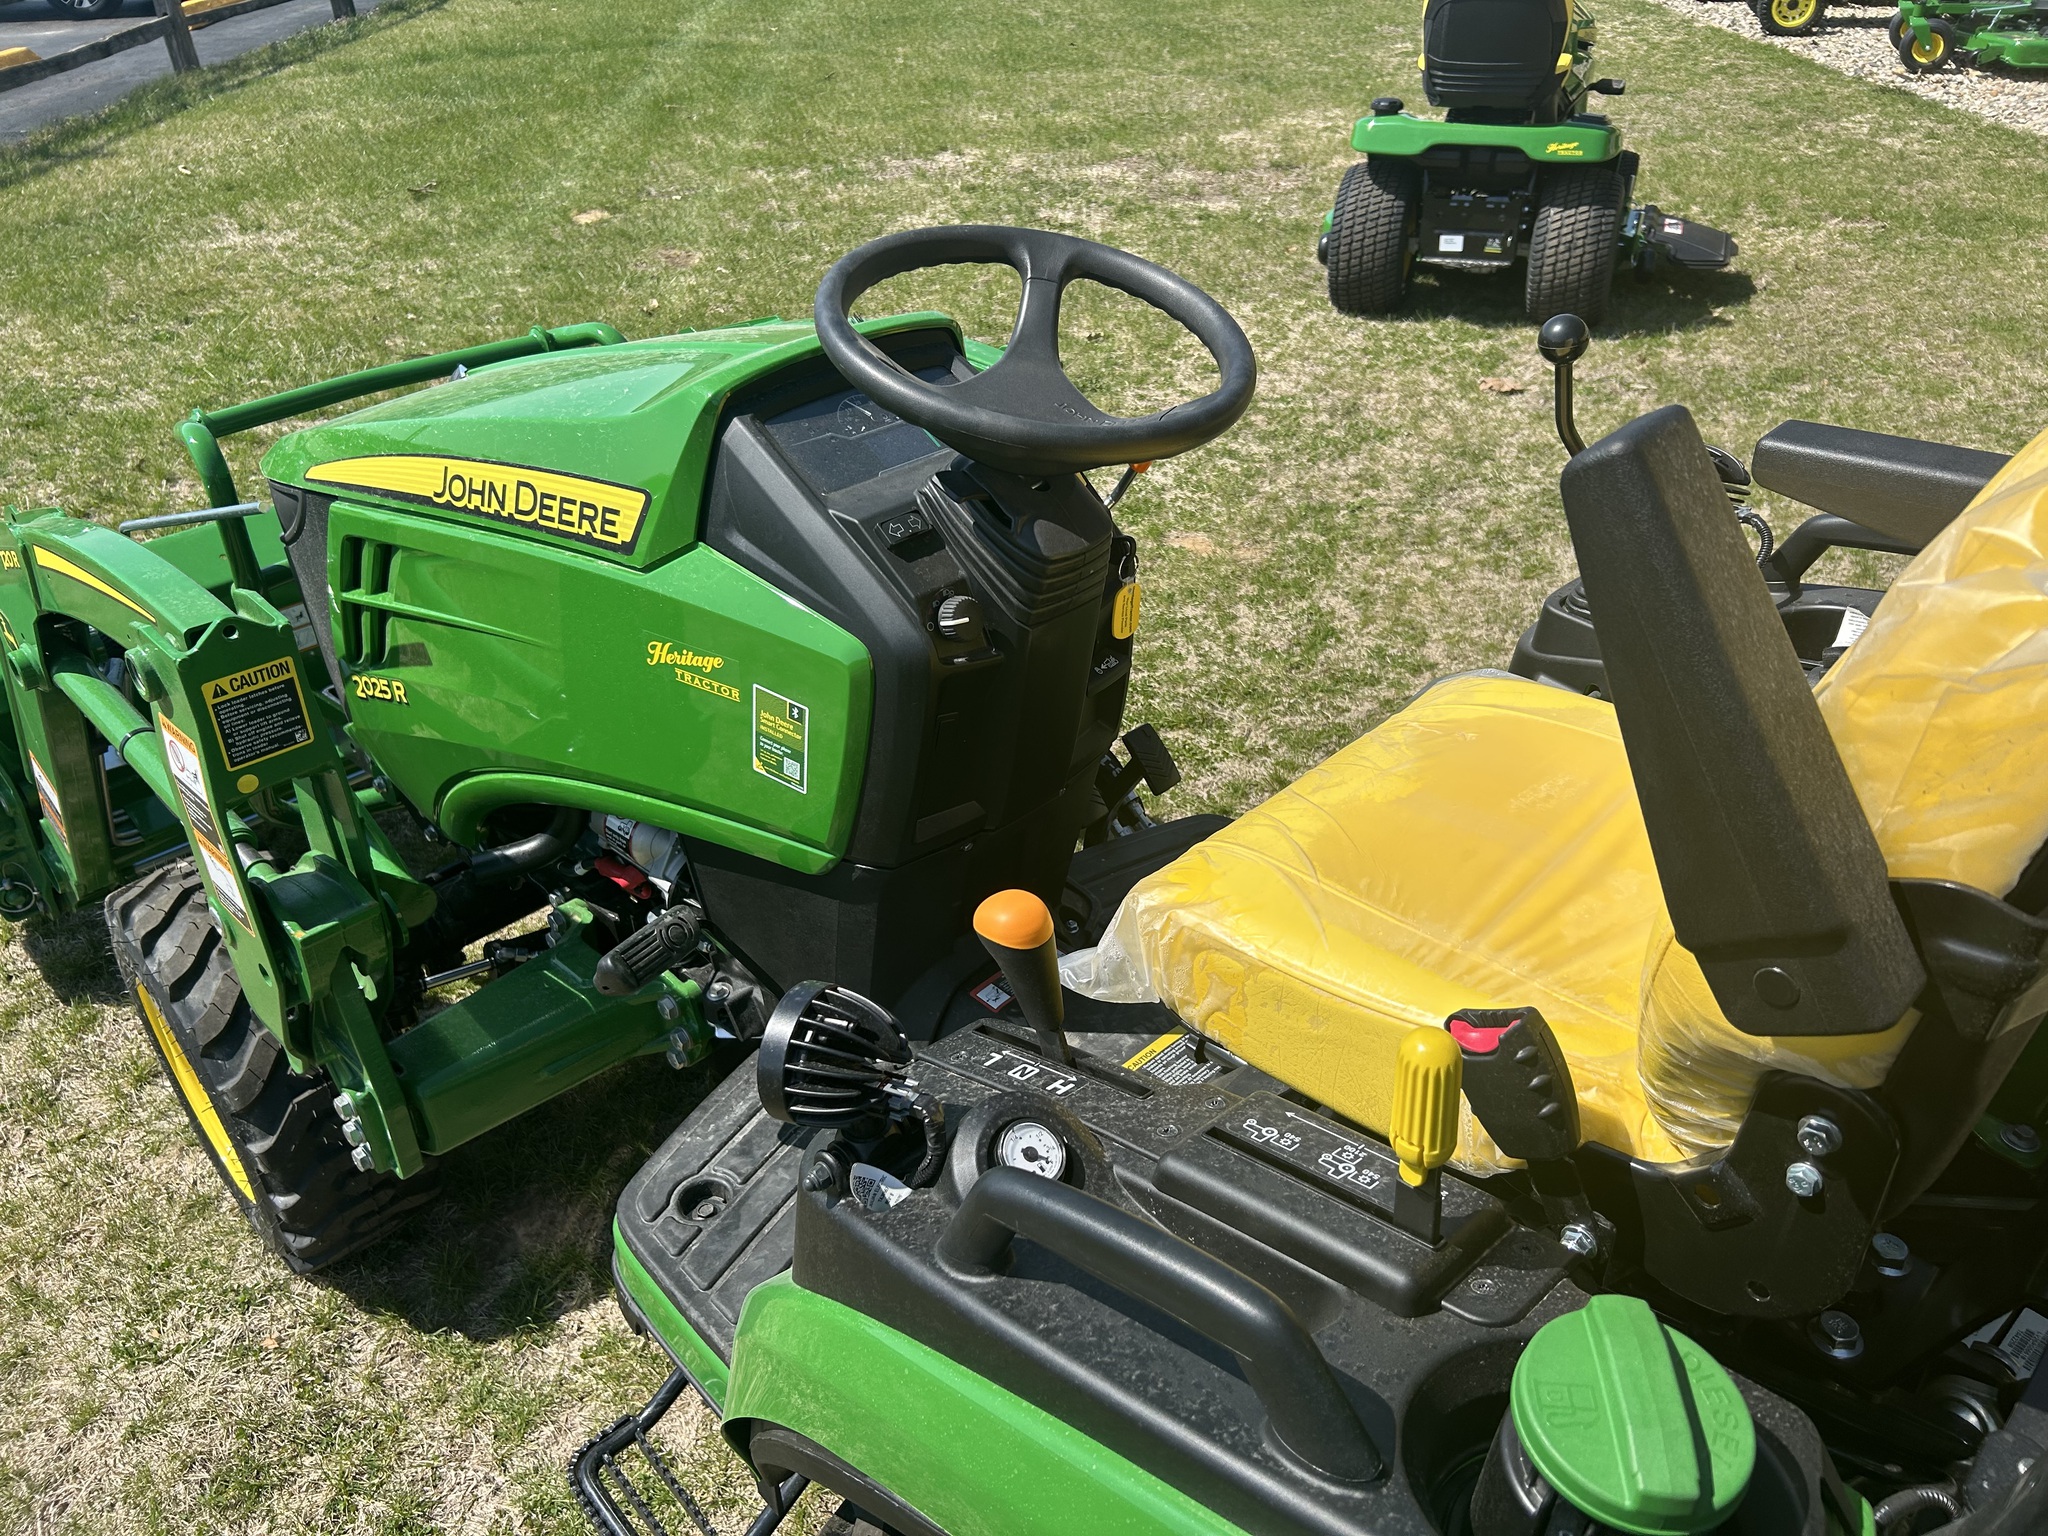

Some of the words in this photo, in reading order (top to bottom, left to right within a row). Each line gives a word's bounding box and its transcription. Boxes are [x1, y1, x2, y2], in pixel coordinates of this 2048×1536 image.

[434, 466, 507, 511] JOHN
[515, 480, 621, 539] DEERE
[646, 641, 724, 673] Heritage
[229, 661, 291, 692] CAUTION
[351, 675, 392, 701] 2025
[391, 680, 409, 704] R
[675, 669, 740, 702] TRACTOR
[1128, 1048, 1157, 1070] CAUTION
[1045, 1079, 1075, 1095] H
[1285, 1132, 1302, 1143] 540
[1362, 1168, 1381, 1180] 540
[1682, 1351, 1739, 1469] DIESEL
